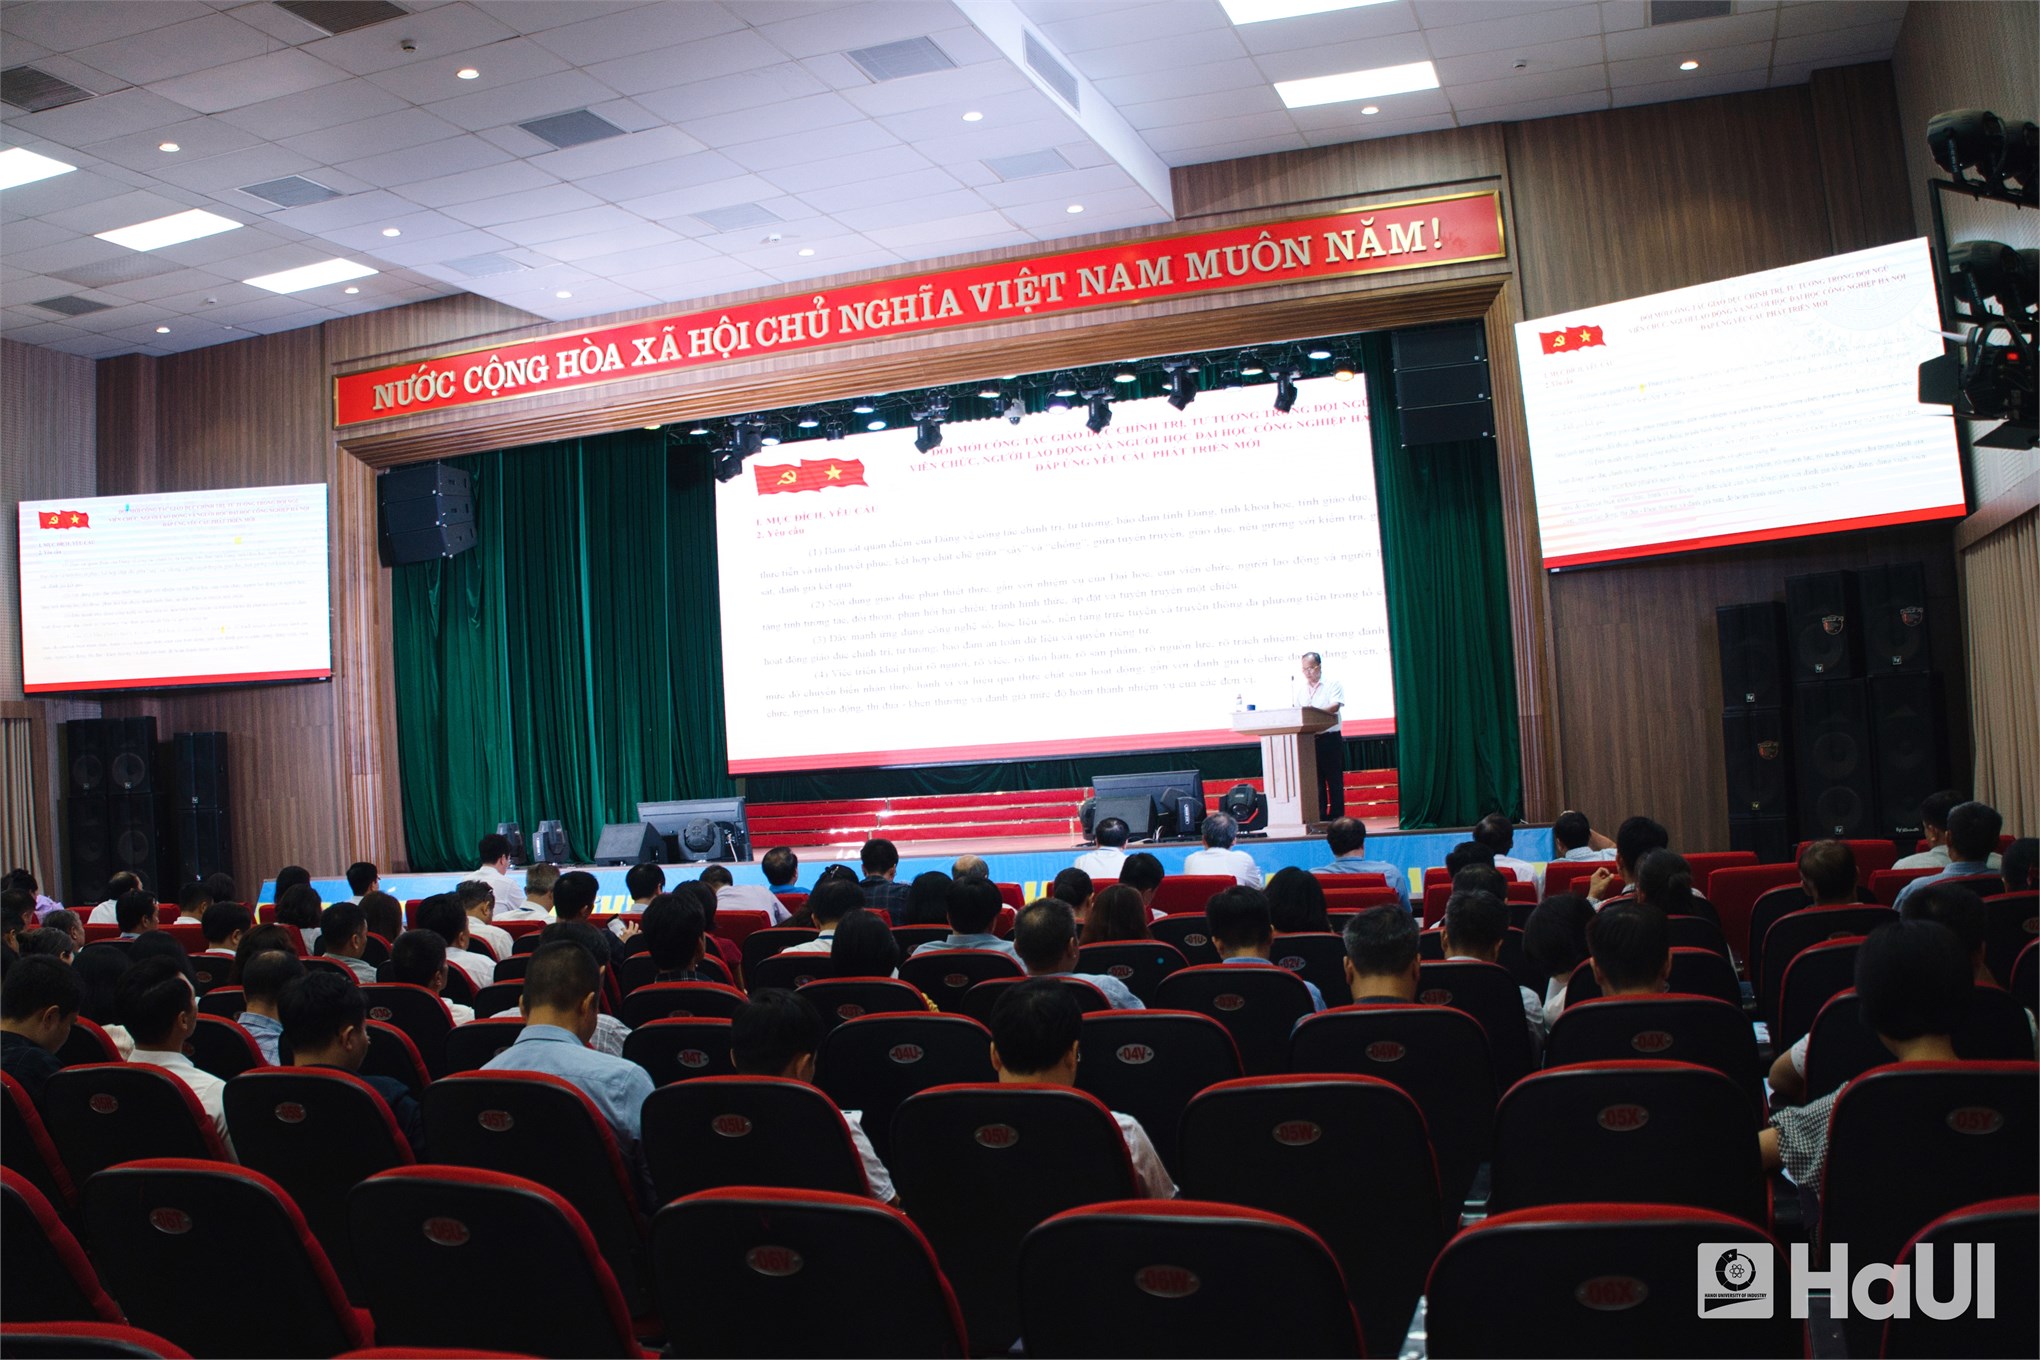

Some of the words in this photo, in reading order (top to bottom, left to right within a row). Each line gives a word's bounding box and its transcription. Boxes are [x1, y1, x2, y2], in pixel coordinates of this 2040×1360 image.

[372, 363, 457, 411] NƯỚC
[463, 353, 549, 396] CỘNG
[556, 339, 624, 380] HÒA
[631, 326, 682, 367] XÃ
[688, 315, 751, 359] HỘI
[756, 301, 832, 344] CHỦ
[838, 284, 962, 335] NGHĨA
[967, 268, 1066, 314] VIỆT
[1077, 256, 1172, 297] NAM
[1185, 231, 1313, 281] MUÔN
[1264, 403, 1312, 416] TRNG
[755, 530, 764, 539] 2.
[895, 1043, 919, 1060] 04U
[1123, 1047, 1145, 1061] 04V
[720, 1115, 746, 1133] 05U
[1605, 1110, 1638, 1127] 05X
[1280, 1124, 1313, 1141] 05W
